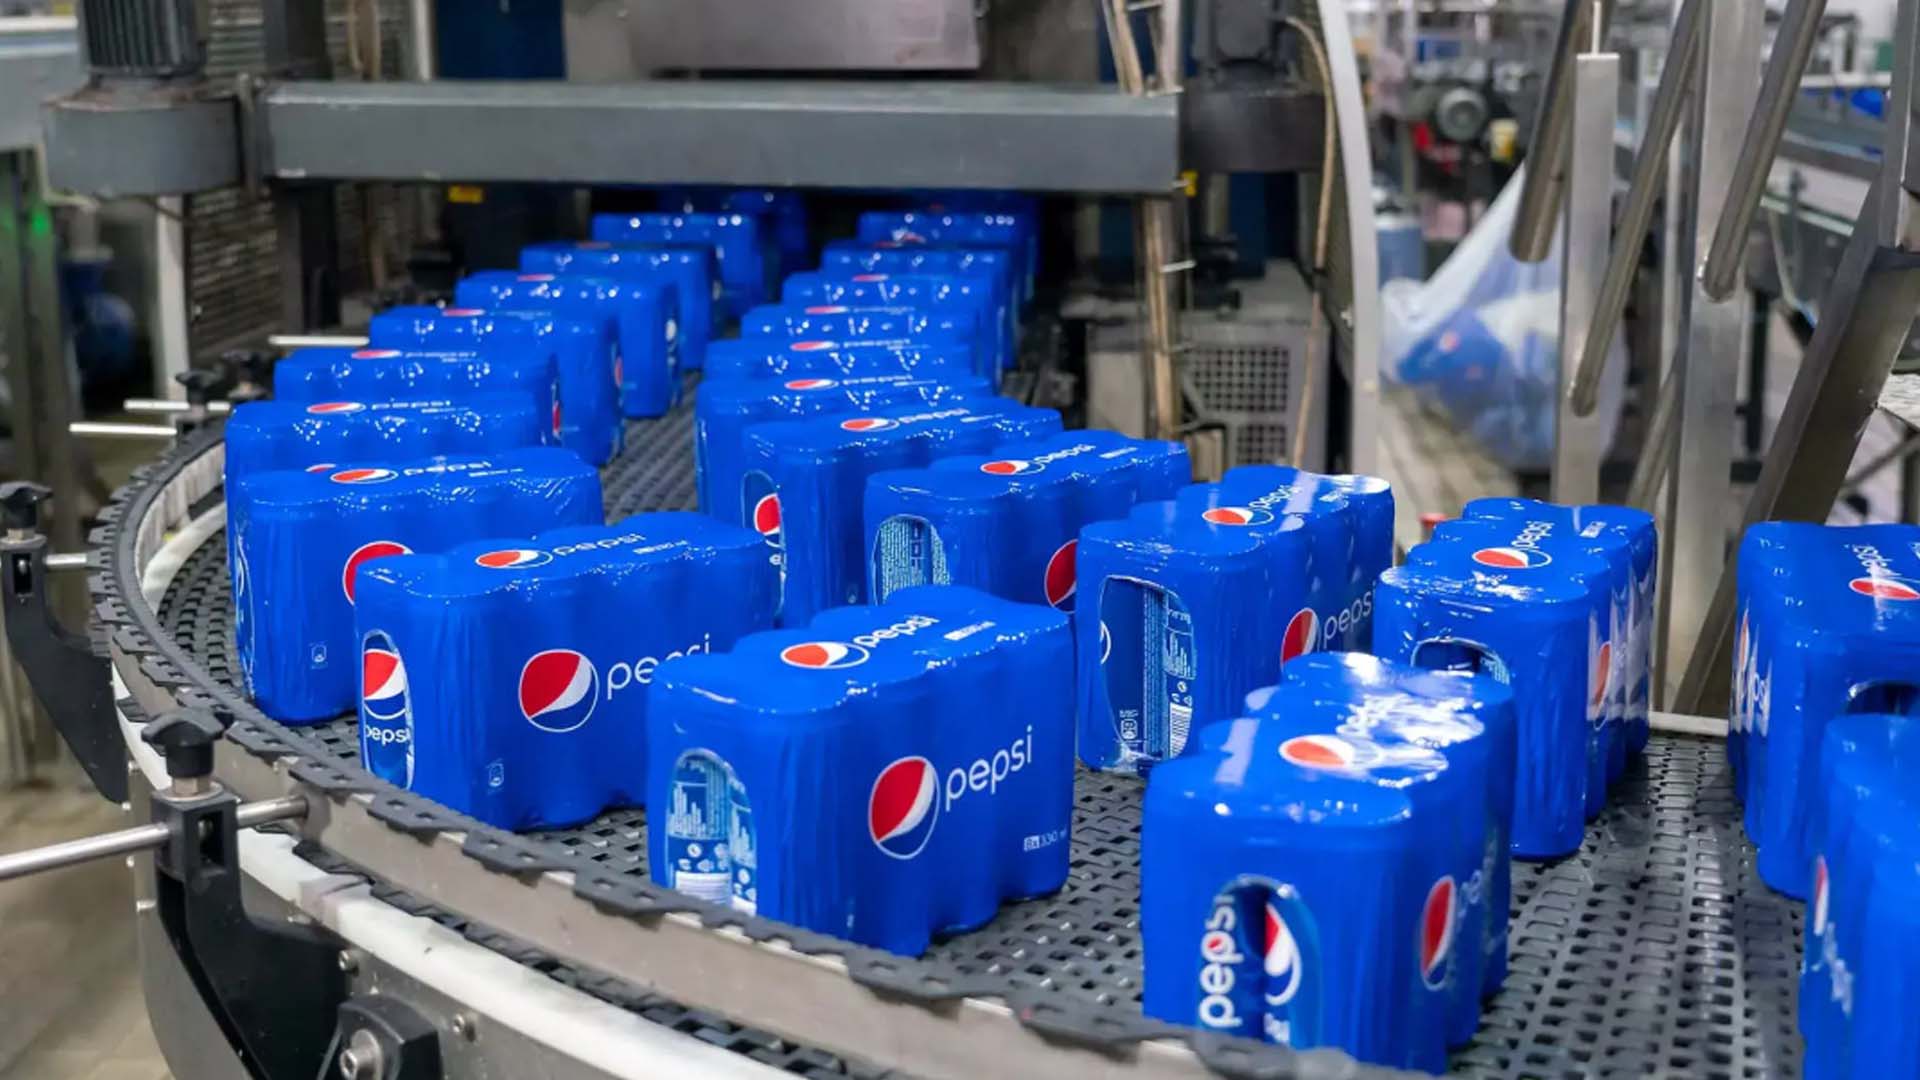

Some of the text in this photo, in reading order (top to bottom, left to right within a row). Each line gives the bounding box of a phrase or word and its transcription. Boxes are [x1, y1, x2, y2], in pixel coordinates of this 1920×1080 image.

[607, 632, 710, 701] pei
[853, 614, 941, 649] pepsi
[945, 723, 1033, 813] pepsi
[1199, 895, 1244, 1028] pepsi
